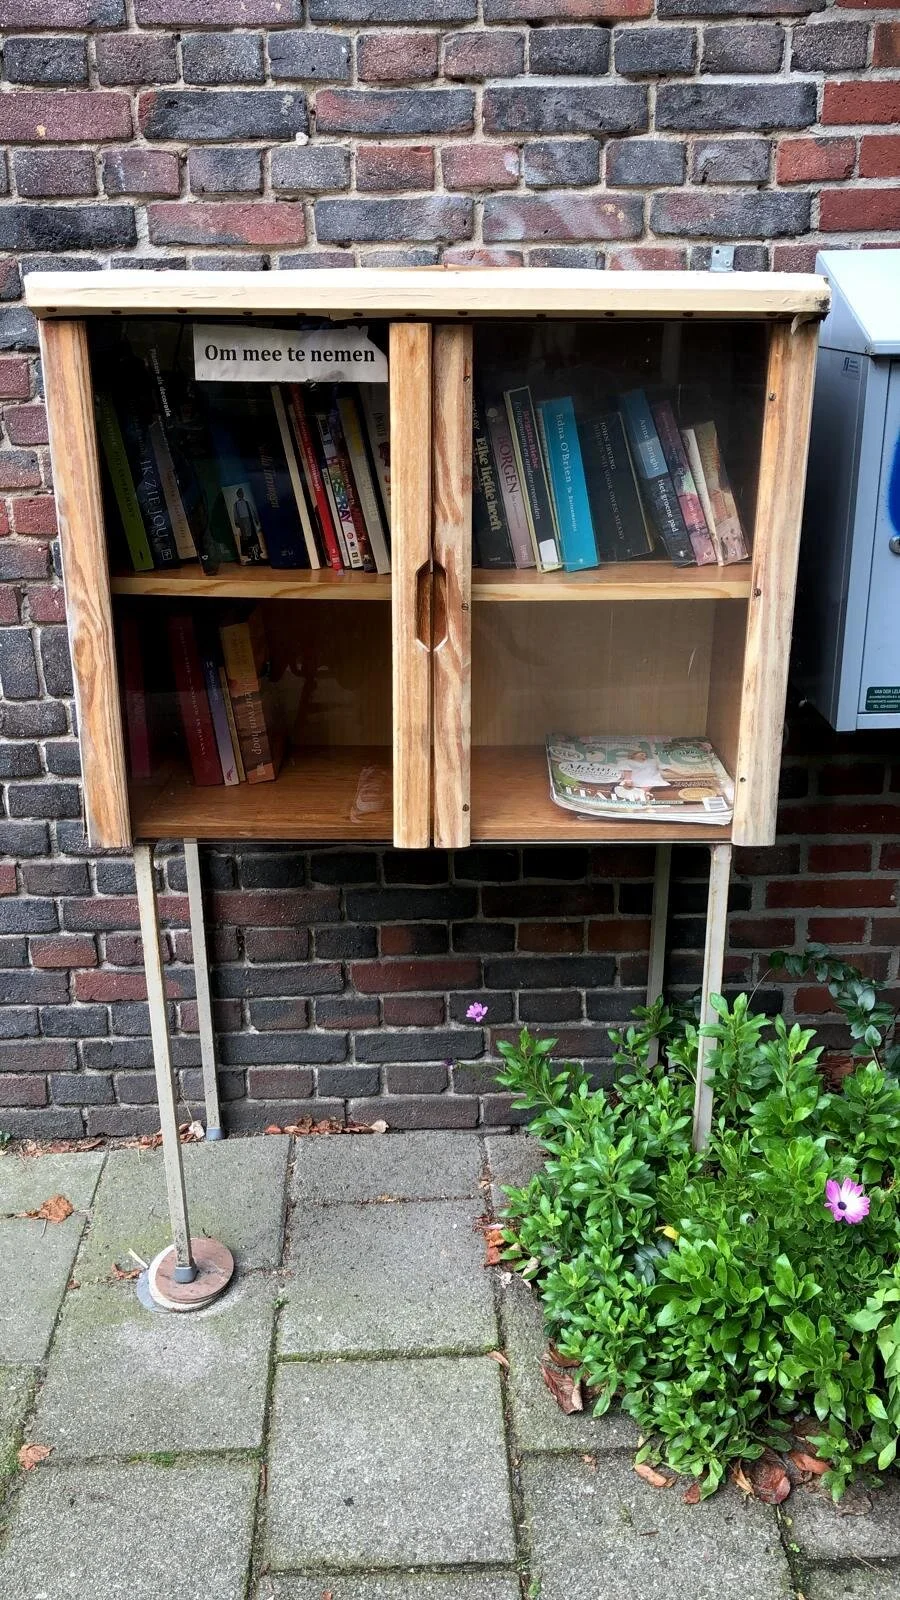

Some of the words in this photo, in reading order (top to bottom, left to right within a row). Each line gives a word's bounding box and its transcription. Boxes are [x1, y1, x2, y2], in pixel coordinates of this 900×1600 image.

[205, 345, 237, 361] Om
[243, 349, 282, 362] mee
[287, 347, 305, 362] te
[310, 349, 375, 362] nemen
[159, 386, 171, 417] decoratie
[556, 414, 566, 440] Edna
[476, 437, 489, 465] Elke
[524, 447, 529, 457] en
[600, 422, 609, 442] JOHN
[605, 444, 617, 470] IRVING
[639, 418, 650, 440] Anne
[645, 440, 662, 471] Enright
[139, 460, 153, 476] IK
[497, 435, 519, 494] BORGEN
[560, 441, 572, 483] O'Brien
[480, 464, 496, 498] liefde
[656, 478, 666, 493] Het
[486, 495, 503, 531] heeft
[660, 493, 674, 518] groene
[668, 518, 679, 533] pad
[246, 709, 257, 729] van
[250, 730, 263, 755] hoop
